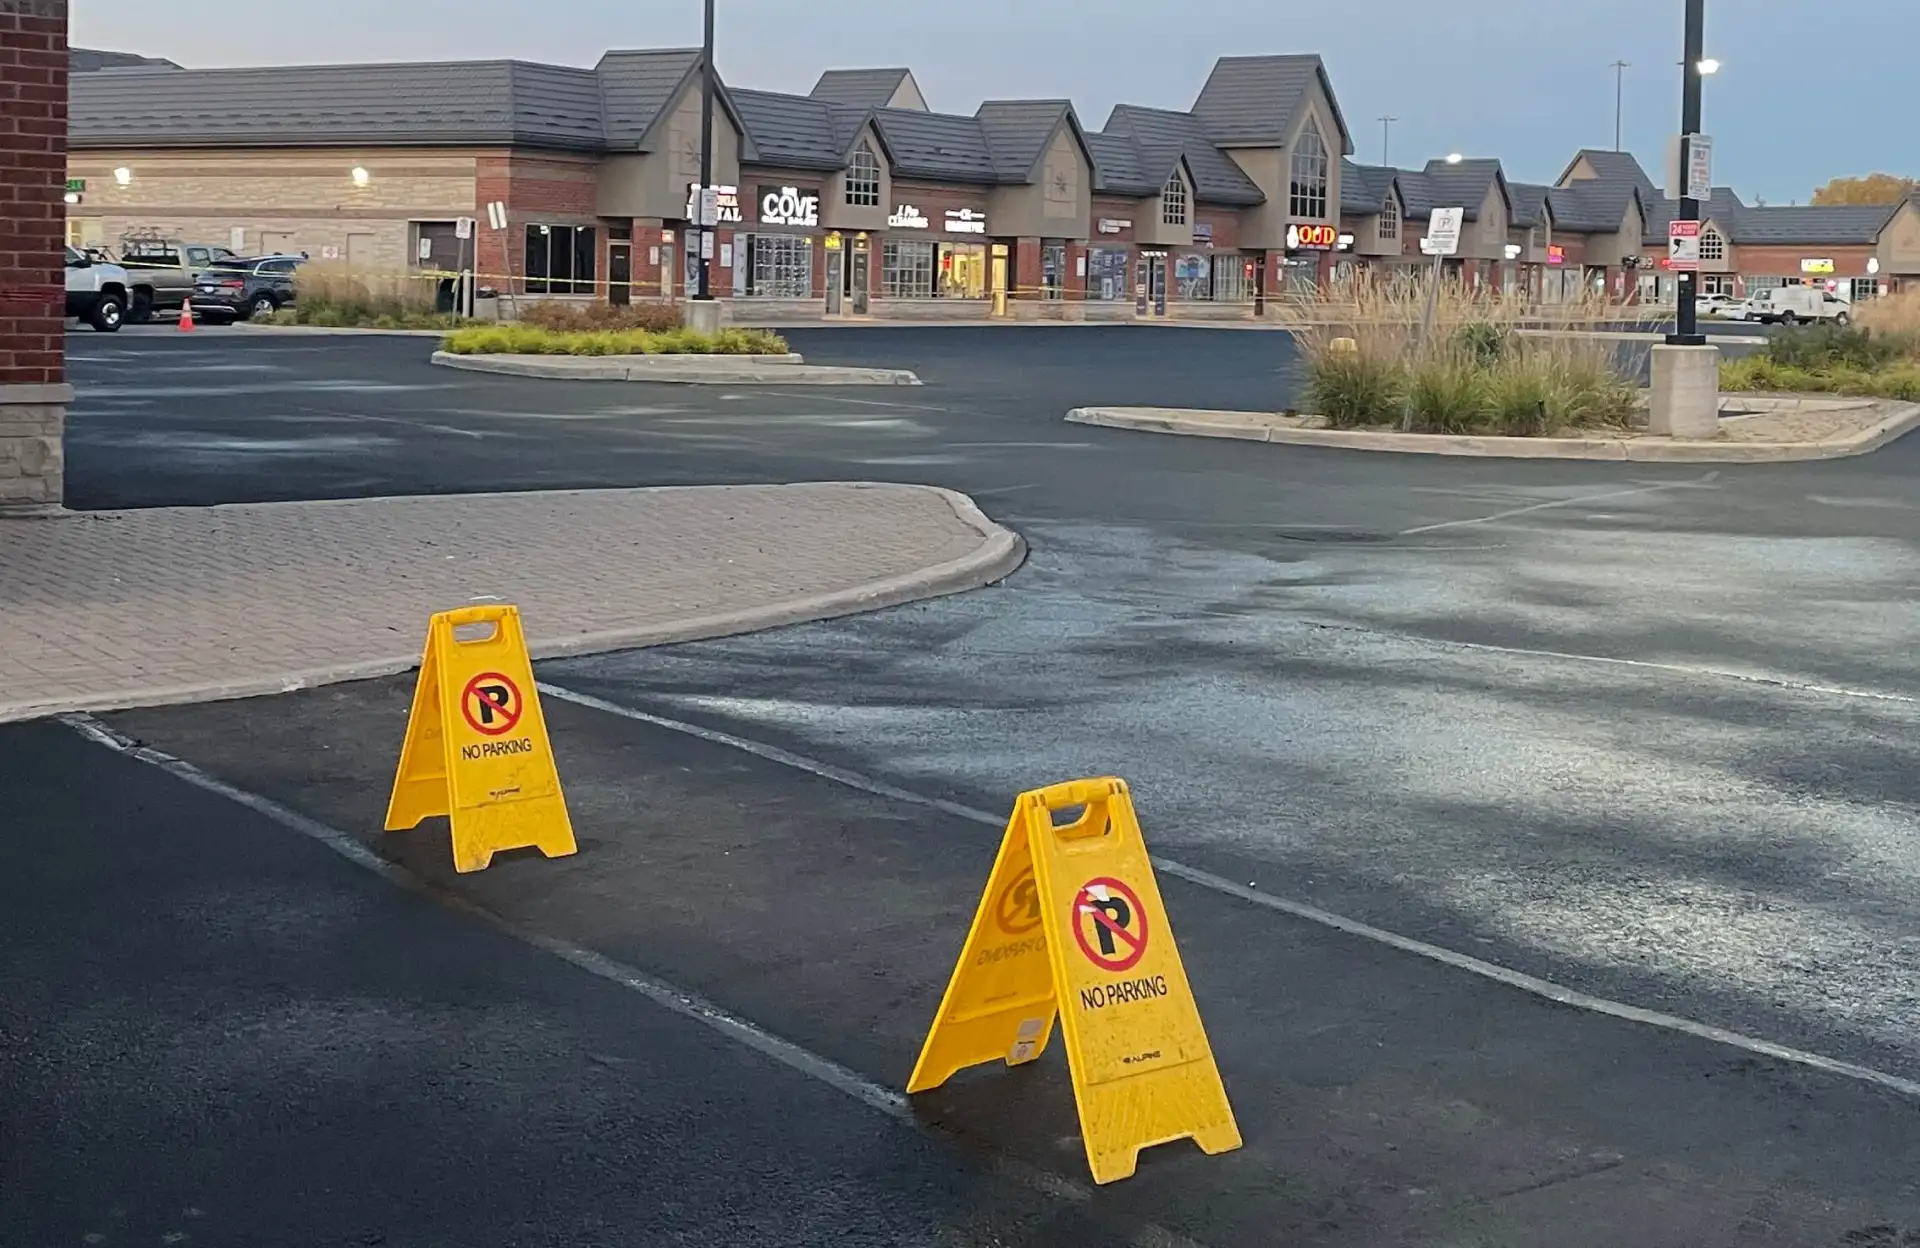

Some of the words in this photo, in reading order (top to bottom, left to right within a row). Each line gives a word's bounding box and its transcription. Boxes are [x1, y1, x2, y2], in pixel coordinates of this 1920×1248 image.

[763, 193, 819, 217] COVE
[462, 743, 480, 761] NO
[482, 738, 532, 758] PARKING
[1080, 987, 1105, 1011] NO
[1106, 975, 1168, 1006] PARKING
